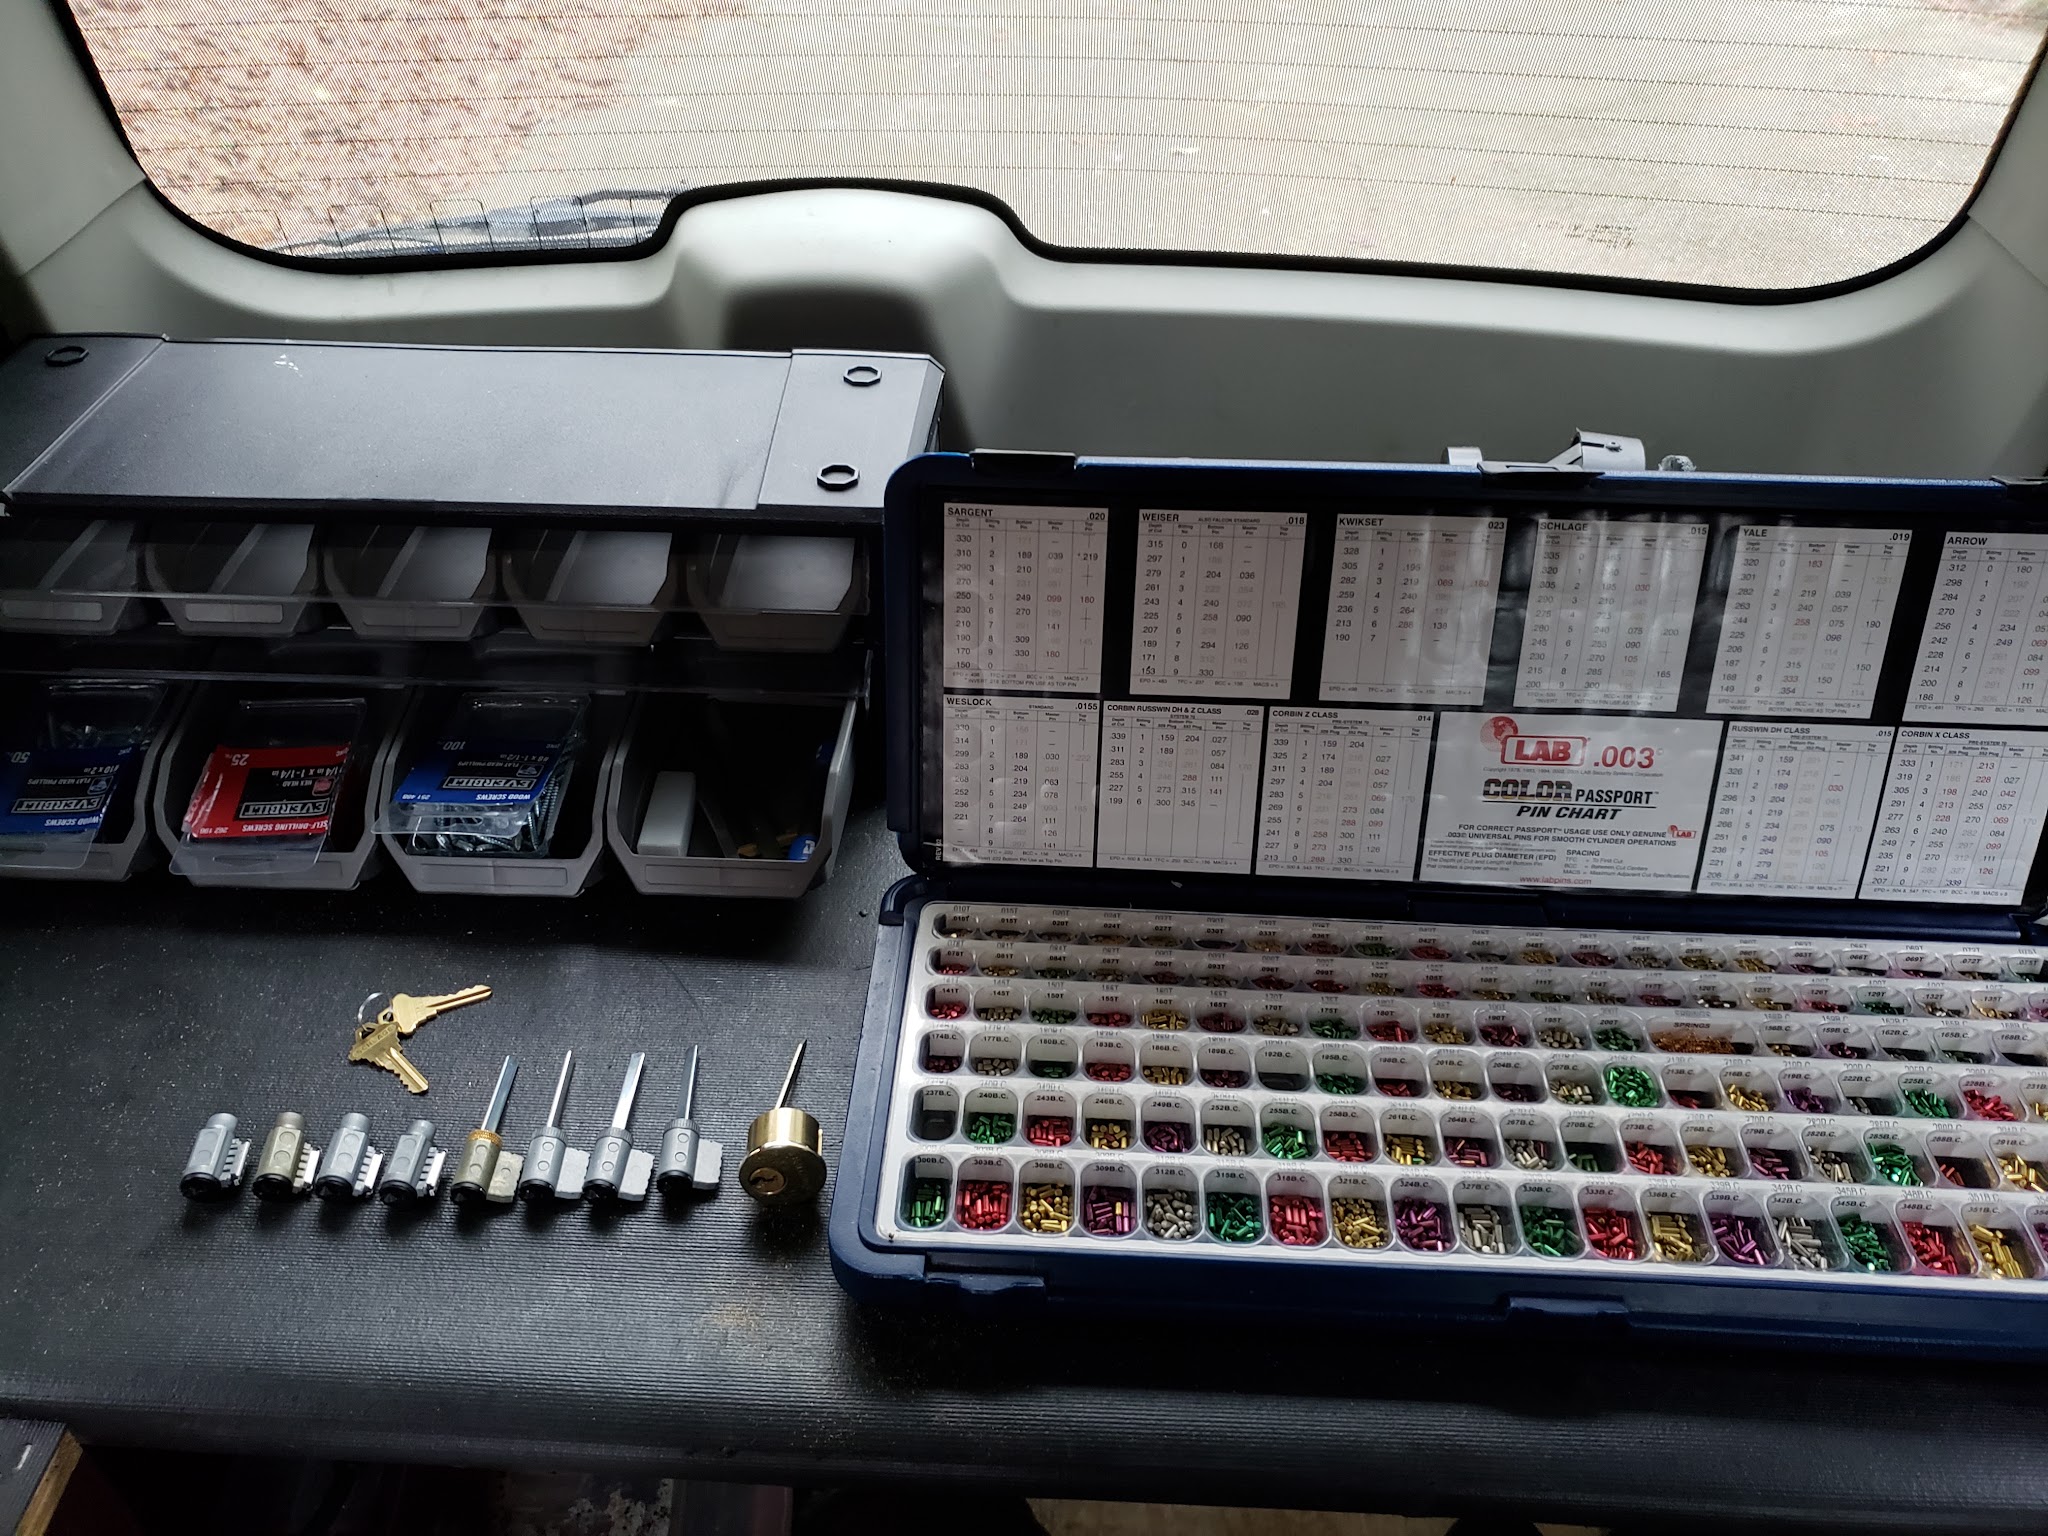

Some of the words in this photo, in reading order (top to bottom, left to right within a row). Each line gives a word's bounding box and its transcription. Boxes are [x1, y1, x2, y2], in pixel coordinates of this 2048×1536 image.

[948, 508, 993, 517] SARGENT
[1142, 513, 1179, 522] WEISER
[1339, 518, 1384, 526] KWIKSET
[1540, 522, 1588, 531] SCHLAGE
[1743, 529, 1767, 537] YALE
[1889, 533, 1910, 541] .019
[1947, 537, 1987, 545] ARROW
[946, 697, 992, 706] WESLOCK
[1137, 705, 1170, 713] RUSSWIN
[1197, 707, 1222, 715] CLASS
[443, 741, 466, 750] 100
[1514, 740, 1571, 762] LAB
[11, 752, 30, 764] 50
[231, 753, 250, 766] 25
[281, 769, 305, 778] 1-1/4
[448, 778, 531, 787] EVERBILT
[1483, 778, 1572, 802] COLOR
[17, 798, 101, 811] EVERBILT
[244, 802, 326, 815] EVERBILT
[1517, 806, 1551, 818] PIN
[1556, 806, 1622, 820] CHART
[44, 818, 77, 826] SCREWS
[275, 821, 328, 831] SELF-DRILLING
[242, 823, 273, 832] SCREWS
[1519, 875, 1592, 886] www.labpins.com
[1673, 1021, 1711, 1029] SPRINGS
